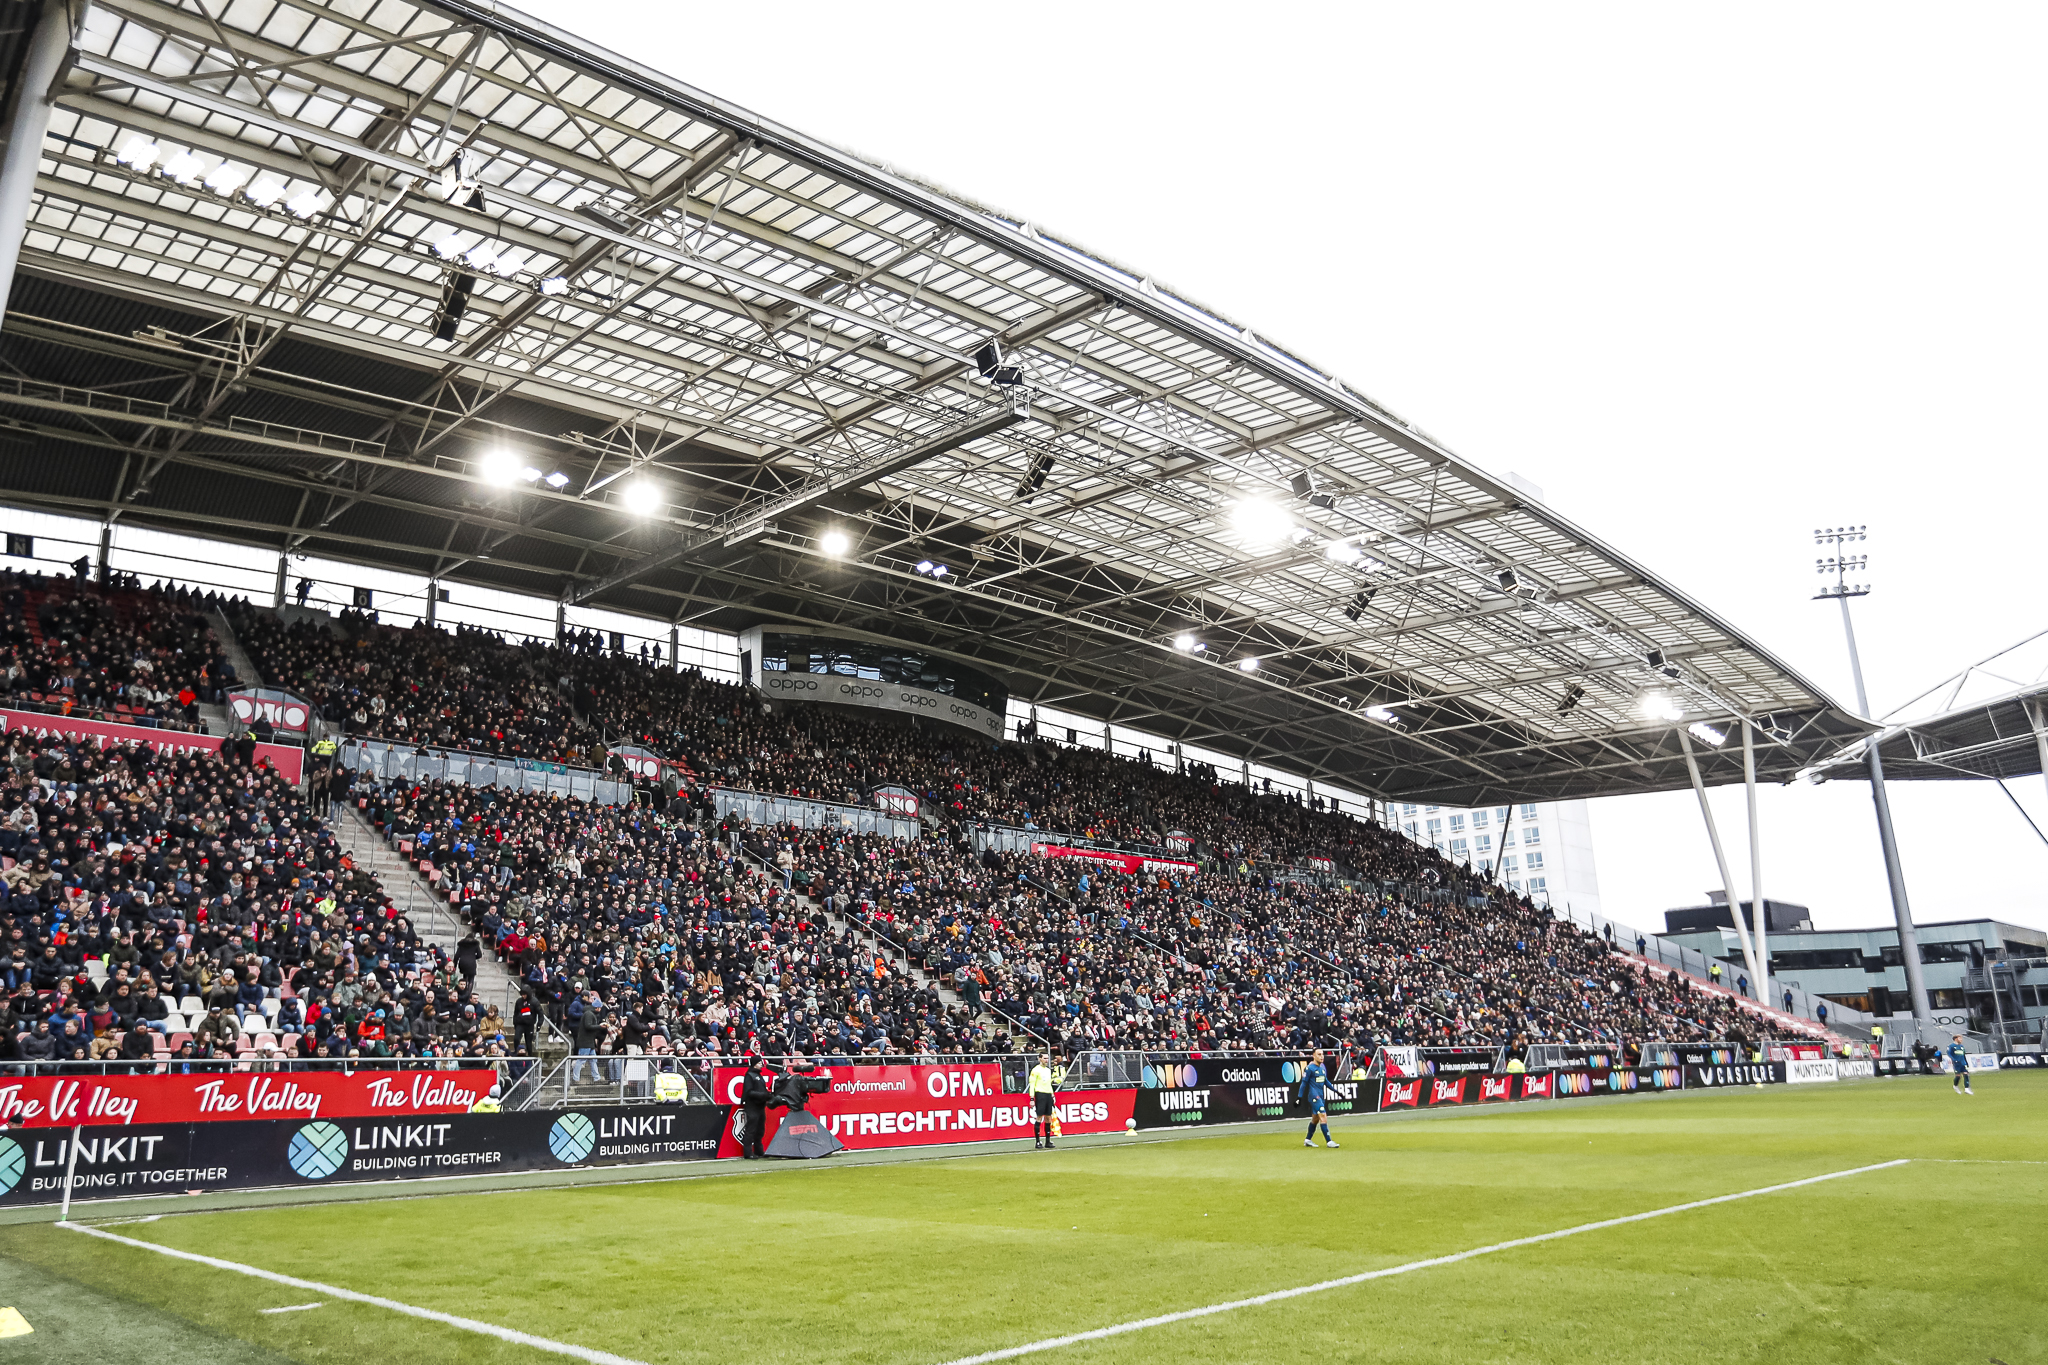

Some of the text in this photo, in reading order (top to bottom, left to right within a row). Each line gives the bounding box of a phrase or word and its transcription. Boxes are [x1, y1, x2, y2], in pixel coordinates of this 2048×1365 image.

[769, 678, 819, 693] oppo
[840, 683, 884, 699] oppo
[901, 692, 937, 708] oppo
[950, 703, 978, 719] oppo
[1837, 1061, 1874, 1077] MUNTSTAD
[2000, 1055, 2037, 1066] STIGA
[1222, 1068, 1261, 1082] Odido.nl
[1794, 1063, 1834, 1079] MUNTSTAD
[833, 1079, 906, 1095] onlyformen.nl
[1323, 1083, 1358, 1100] NIBET
[1387, 1082, 1413, 1103] Bud
[1435, 1080, 1459, 1100] Bud
[1483, 1077, 1505, 1097] Bud
[1525, 1075, 1547, 1094] Bud
[0, 1084, 45, 1119] The
[195, 1075, 322, 1119] The Valley
[367, 1074, 477, 1114] The Valley
[1159, 1090, 1211, 1110] UNIBET
[1246, 1087, 1290, 1105] UNIBET
[600, 1115, 676, 1138] LINKIT
[789, 1124, 819, 1136] ESPN
[355, 1123, 452, 1150] LINKIT
[34, 1135, 164, 1168] LINKIT
[600, 1139, 717, 1156] BUILDING IT TOGETHER
[353, 1151, 502, 1171] BUILDING IT TOGETHER
[121, 1171, 137, 1185] IT
[140, 1167, 228, 1184] TOGETHER
